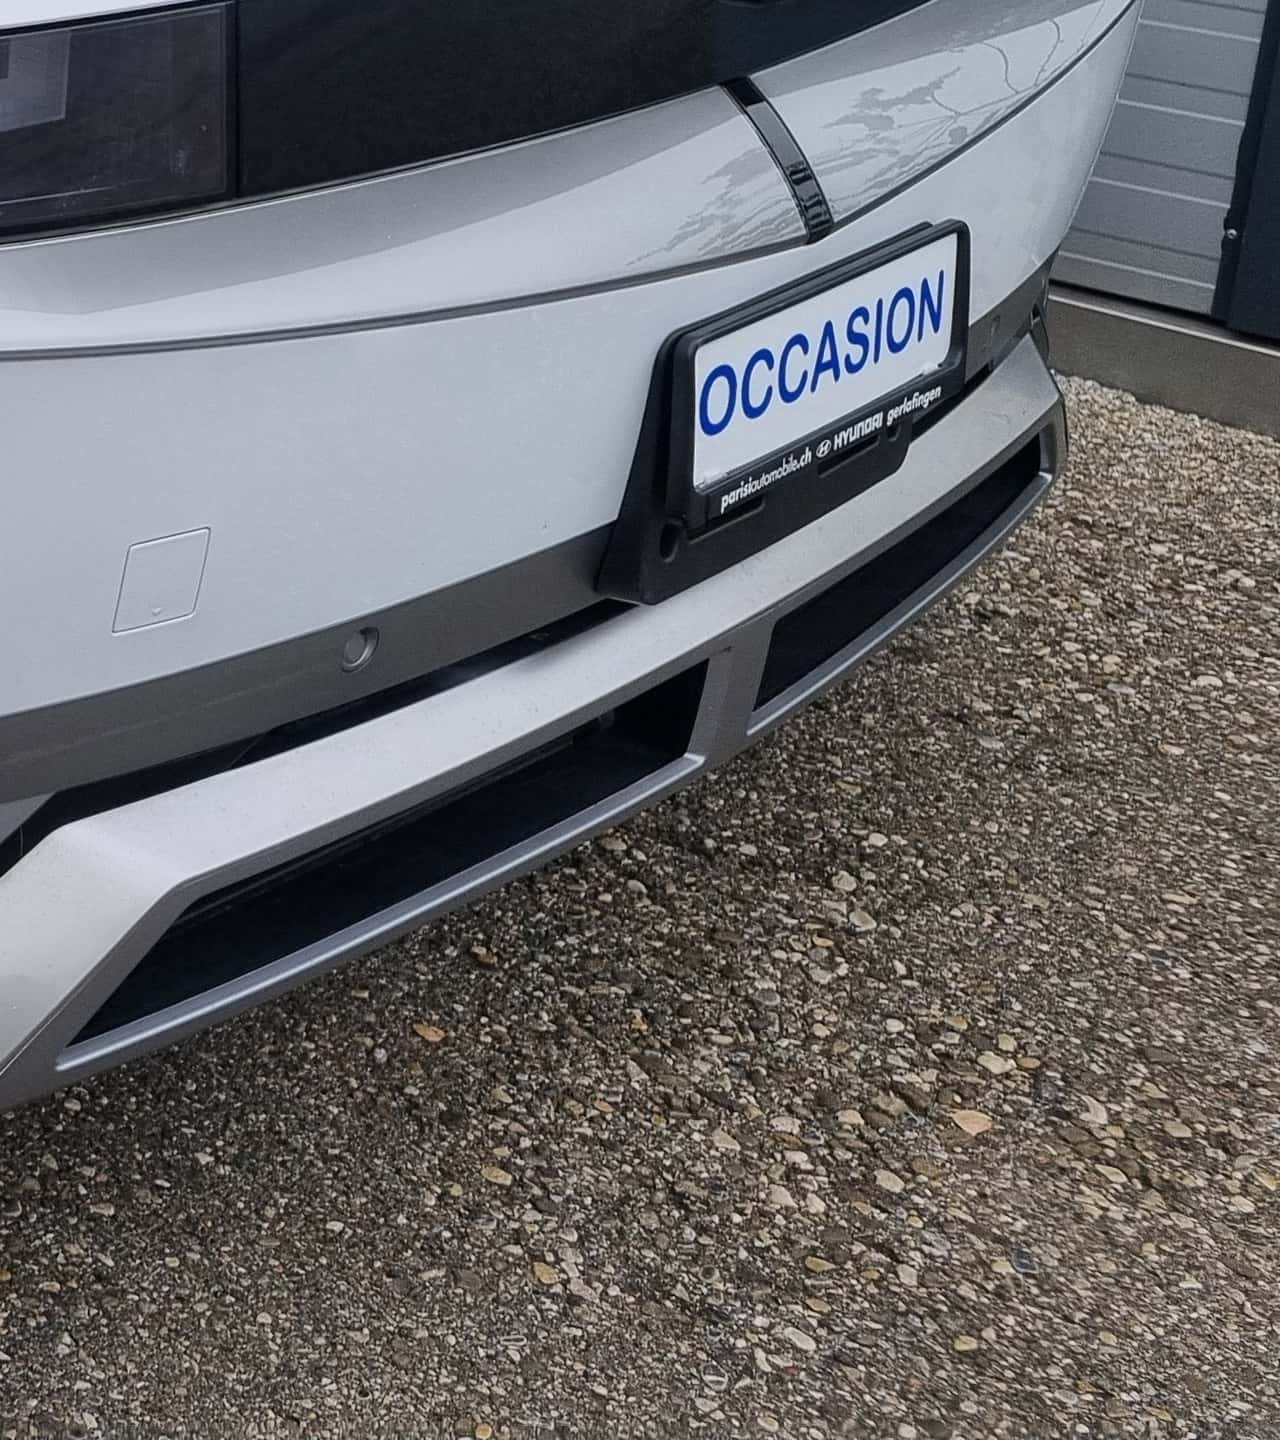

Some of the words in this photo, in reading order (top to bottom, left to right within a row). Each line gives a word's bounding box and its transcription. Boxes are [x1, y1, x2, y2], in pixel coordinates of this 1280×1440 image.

[700, 269, 944, 437] OCCASION
[720, 446, 812, 514] parisiautomobile.ch
[833, 411, 883, 451] HYUNDAI
[887, 386, 942, 425] gerlafingen
